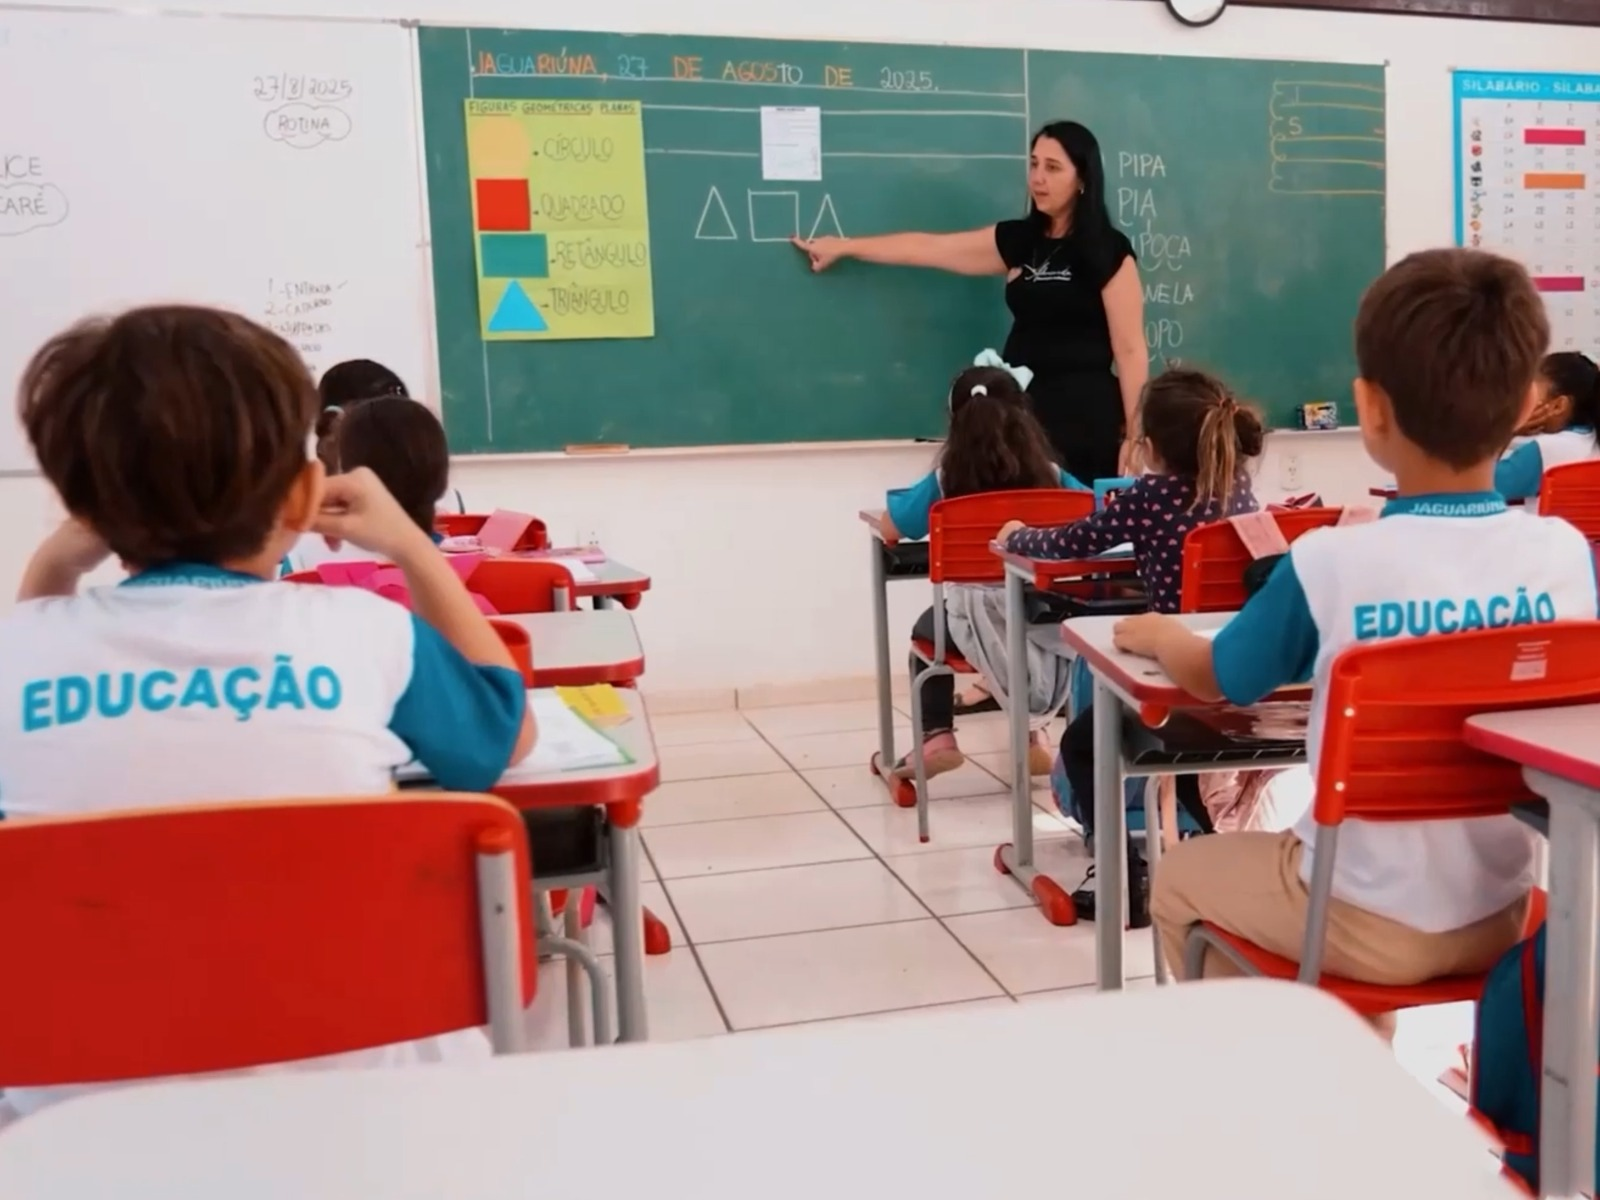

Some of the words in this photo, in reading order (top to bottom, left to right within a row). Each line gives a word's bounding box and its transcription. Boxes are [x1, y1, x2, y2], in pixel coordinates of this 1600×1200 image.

[617, 54, 649, 78] 27
[672, 56, 704, 80] DE
[721, 60, 804, 85] AGOSTO
[824, 65, 854, 88] DE
[468, 101, 517, 113] FIGURAS
[279, 114, 330, 134] ROTINA
[0, 154, 43, 180] ICE
[1119, 151, 1167, 178] PIPA
[1118, 187, 1158, 218] PIA
[1146, 318, 1184, 349] OPO
[21, 654, 343, 732] EDUCAÇÃO
